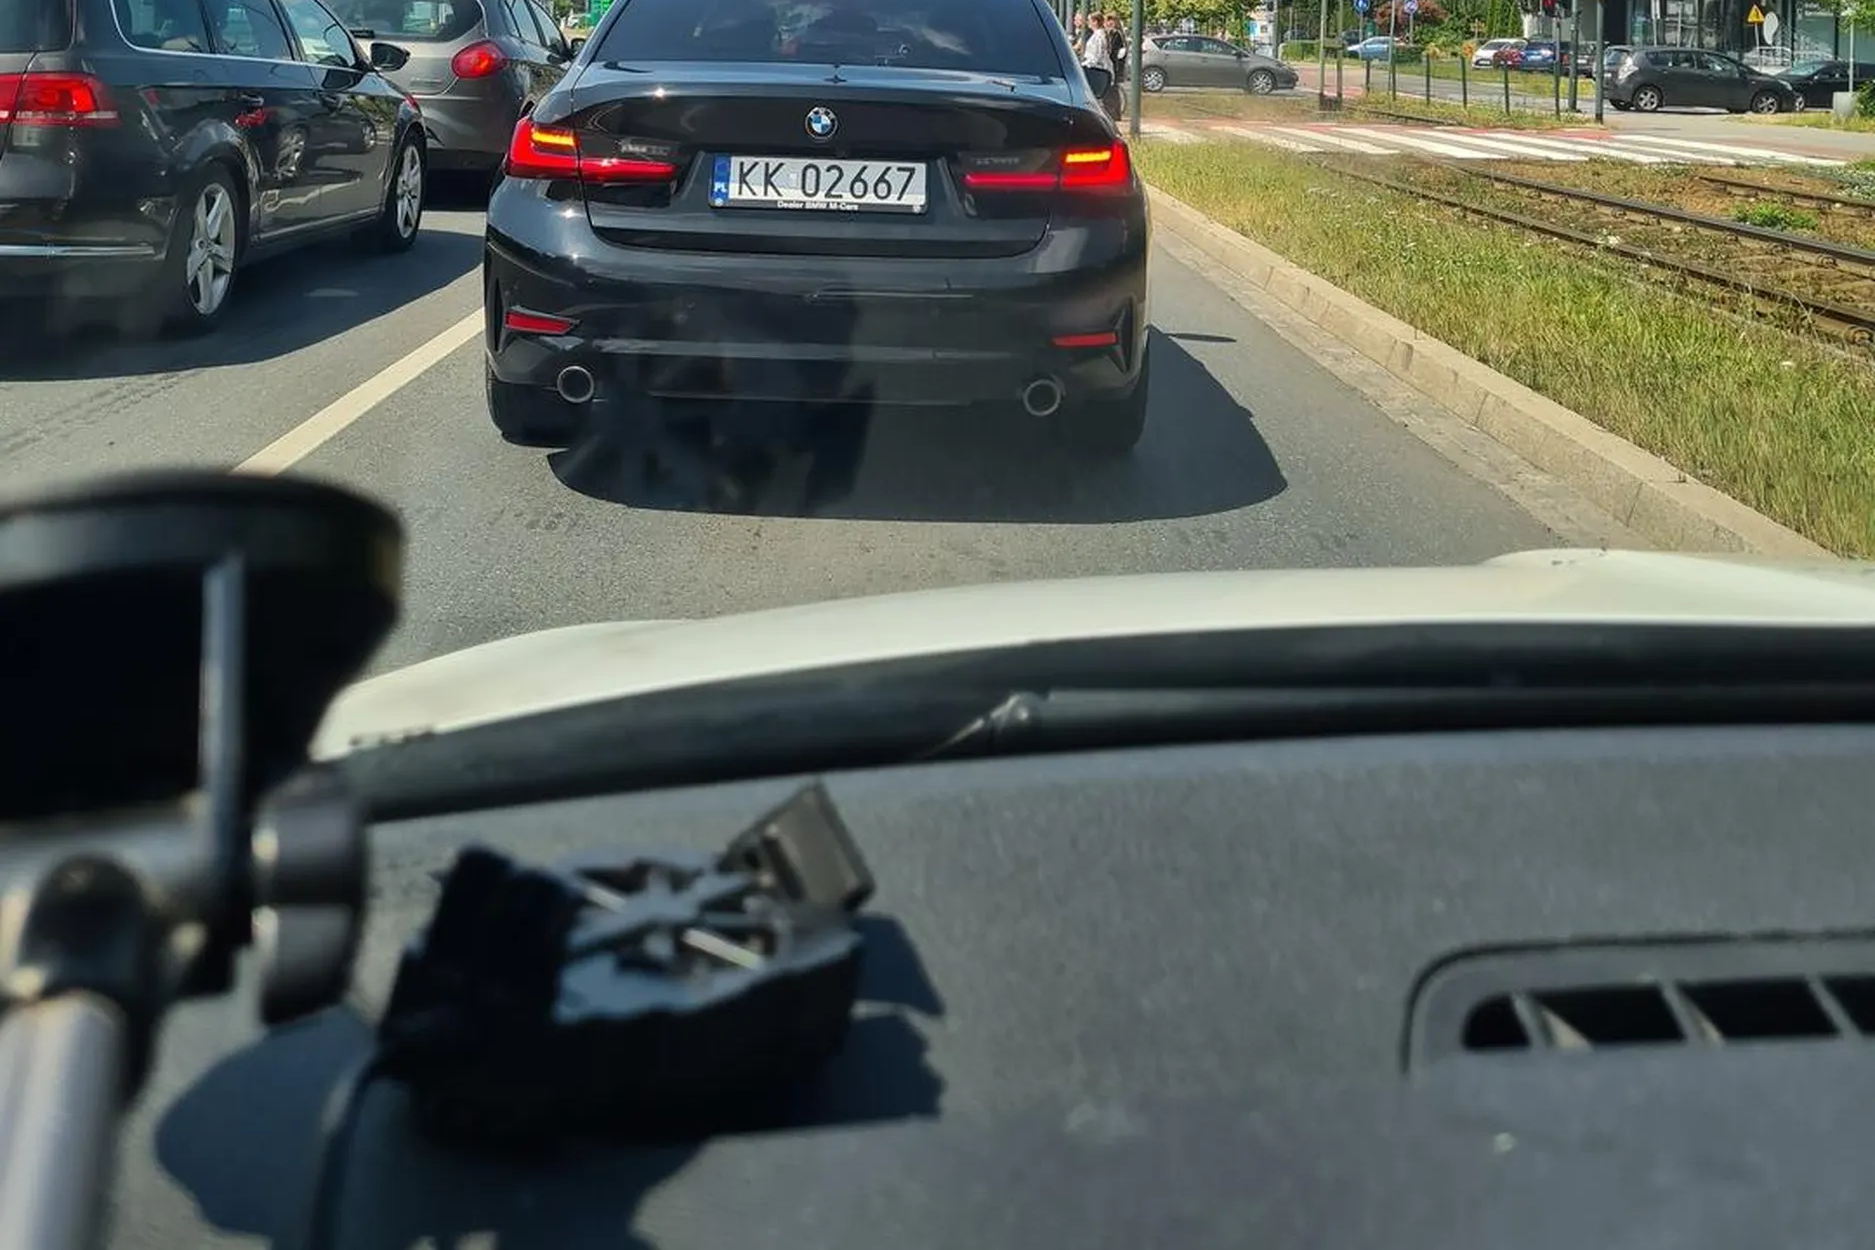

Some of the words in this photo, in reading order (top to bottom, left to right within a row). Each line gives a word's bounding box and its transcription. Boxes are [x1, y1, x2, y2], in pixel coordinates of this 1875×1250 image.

[714, 182, 727, 193] PL
[738, 161, 785, 197] KK
[801, 163, 916, 201] 02667
